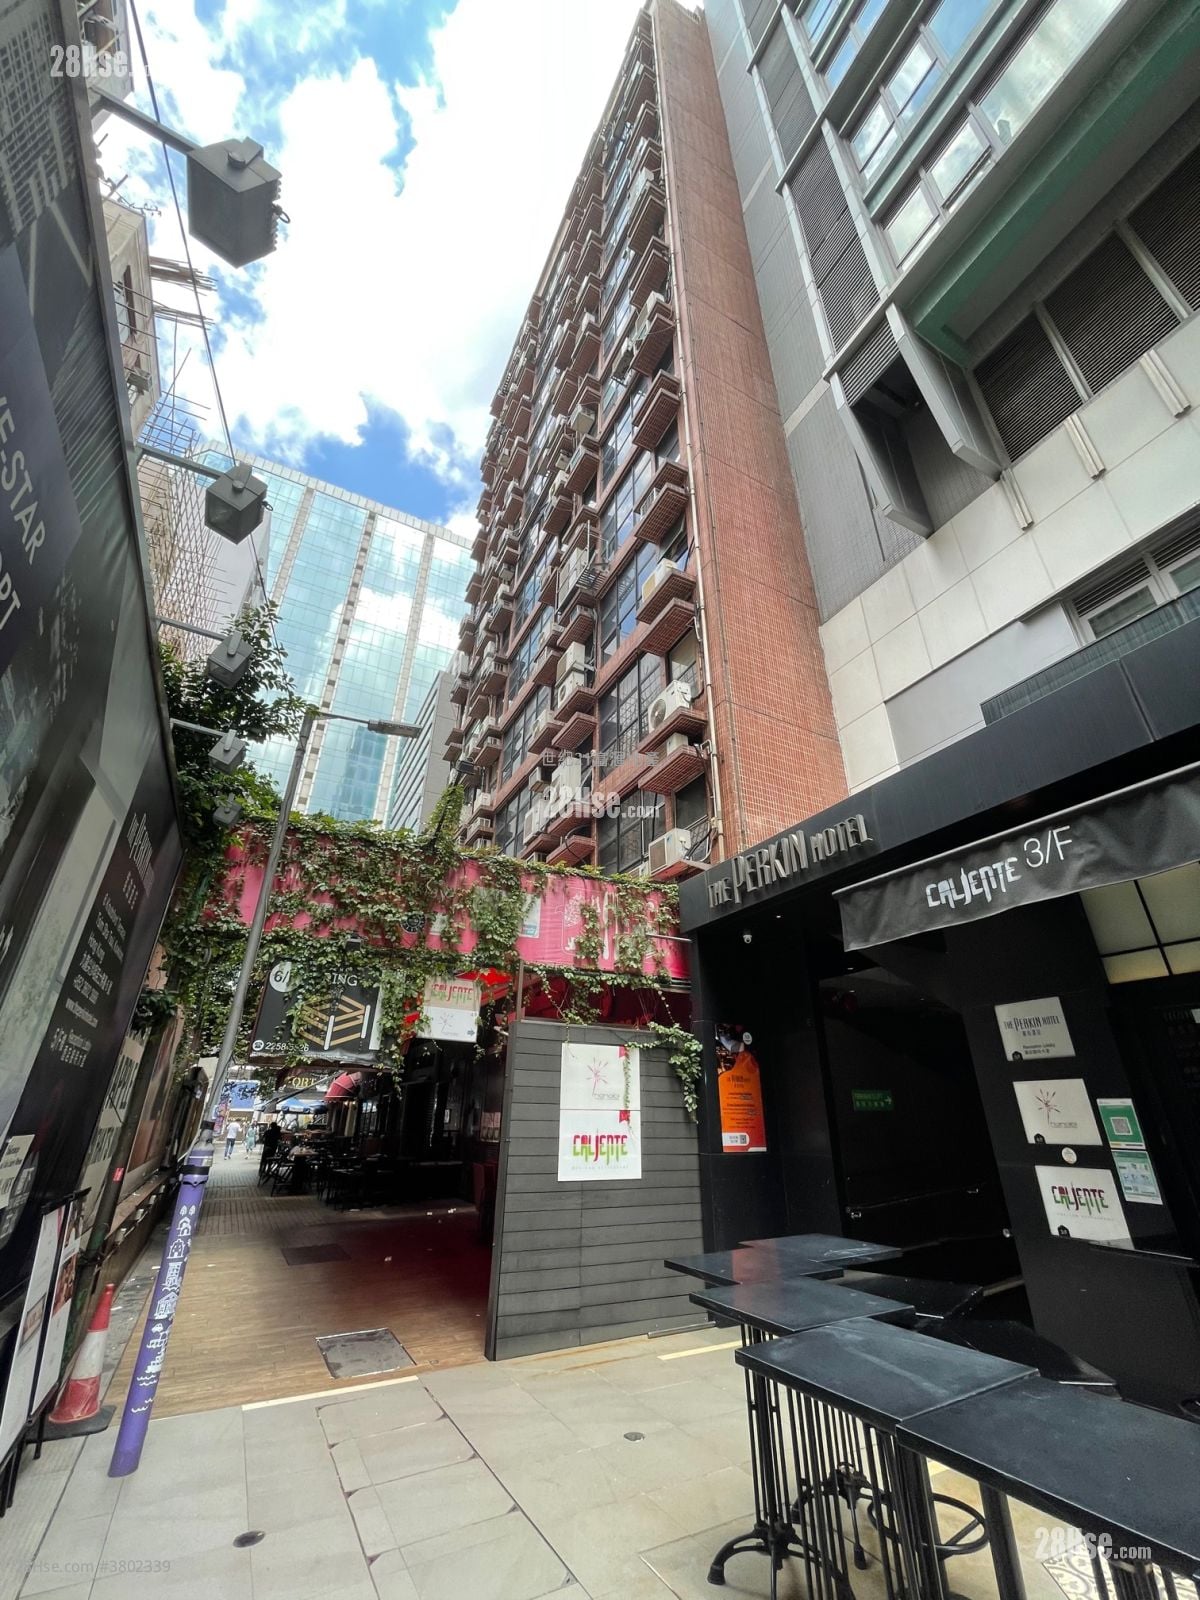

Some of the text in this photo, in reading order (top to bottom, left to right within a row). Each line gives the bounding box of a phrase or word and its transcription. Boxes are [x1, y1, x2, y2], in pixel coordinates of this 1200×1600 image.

[0, 396, 46, 566] E-STAR
[708, 814, 873, 907] THE PERKIN HOTEL
[1023, 825, 1073, 868] 3/F
[331, 972, 358, 987] ING
[1013, 1016, 1042, 1031] PERKIN
